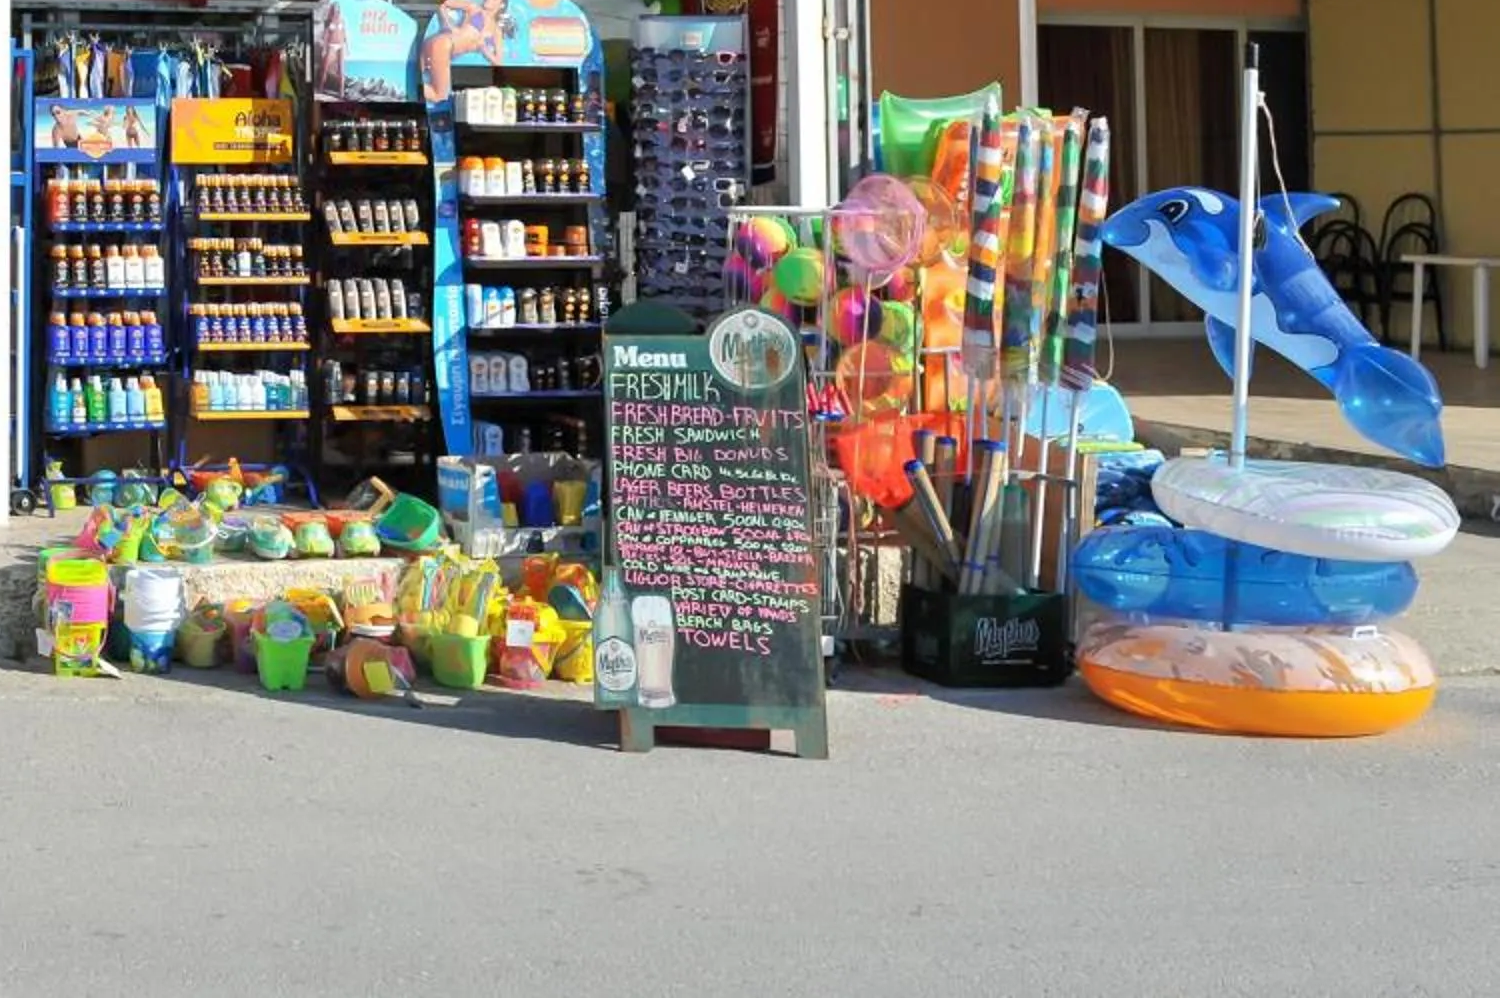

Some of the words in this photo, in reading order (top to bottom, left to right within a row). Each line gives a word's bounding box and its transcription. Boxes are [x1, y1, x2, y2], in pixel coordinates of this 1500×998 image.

[613, 345, 688, 368] Menu
[610, 402, 667, 427] FRESH
[611, 426, 664, 444] FRESH
[674, 428, 760, 444] SANDWICH
[611, 445, 667, 462] FRESH
[612, 461, 666, 479] PHONE
[671, 464, 713, 481] CARD
[613, 478, 661, 496] LAGER
[667, 481, 713, 499] BEERS
[719, 483, 807, 503] BOTTLES
[671, 587, 706, 602] POST
[676, 613, 723, 630] BEACH
[677, 628, 771, 656] TOWELS
